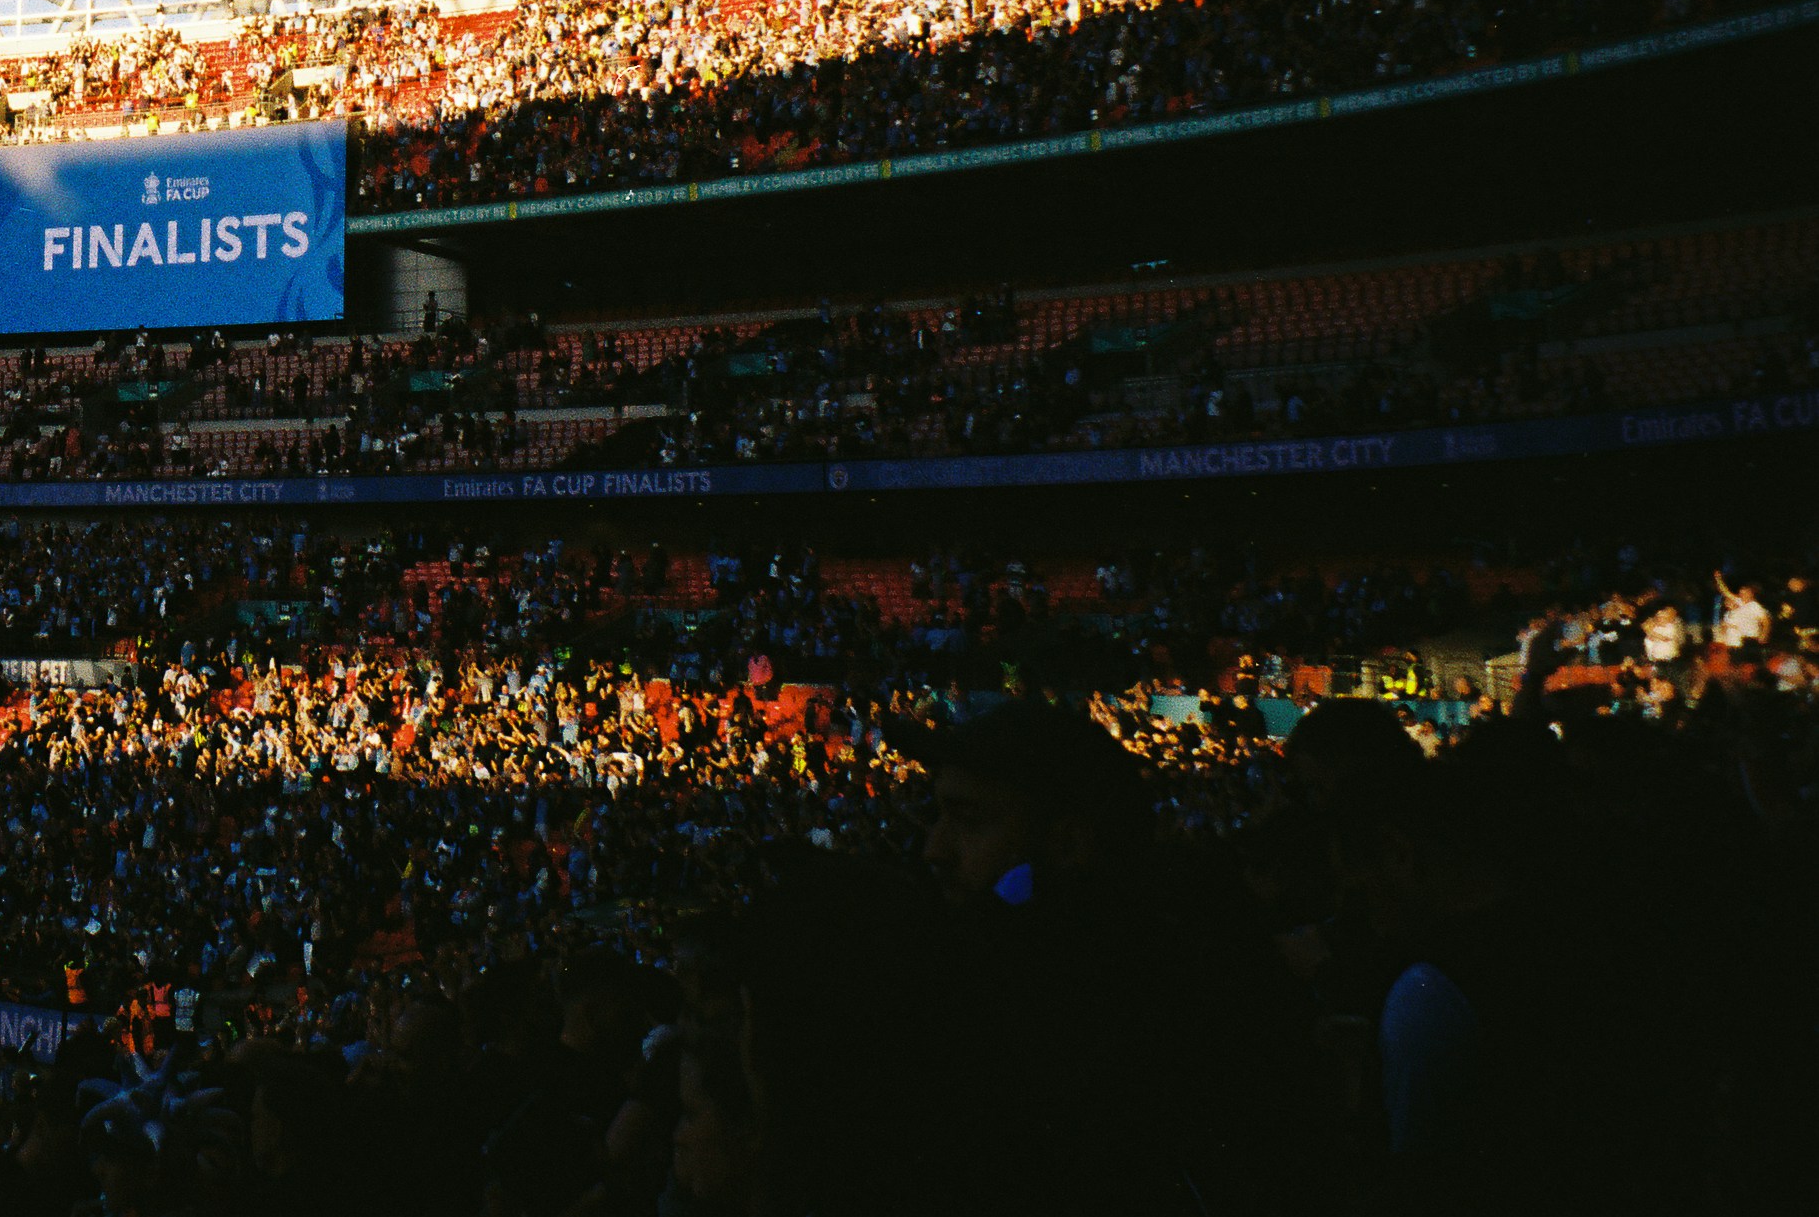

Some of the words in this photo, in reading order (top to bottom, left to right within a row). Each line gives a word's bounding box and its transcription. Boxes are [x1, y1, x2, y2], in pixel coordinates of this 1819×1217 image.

[166, 176, 210, 188] Emirates
[166, 188, 182, 202] FA
[183, 186, 210, 200] CUP
[43, 210, 310, 272] FINALISTS
[1621, 412, 1723, 444] Emirates
[1734, 400, 1768, 431] FA
[1774, 392, 1819, 427] CU
[1139, 441, 1324, 476] MANCHESTER
[1332, 437, 1396, 465] CITY
[104, 483, 234, 503] MANCHESTER
[239, 482, 284, 502] CITY
[443, 476, 515, 499] Emirates
[522, 476, 547, 497] FA
[552, 474, 595, 496] CUP
[603, 471, 712, 495] FINALISTS
